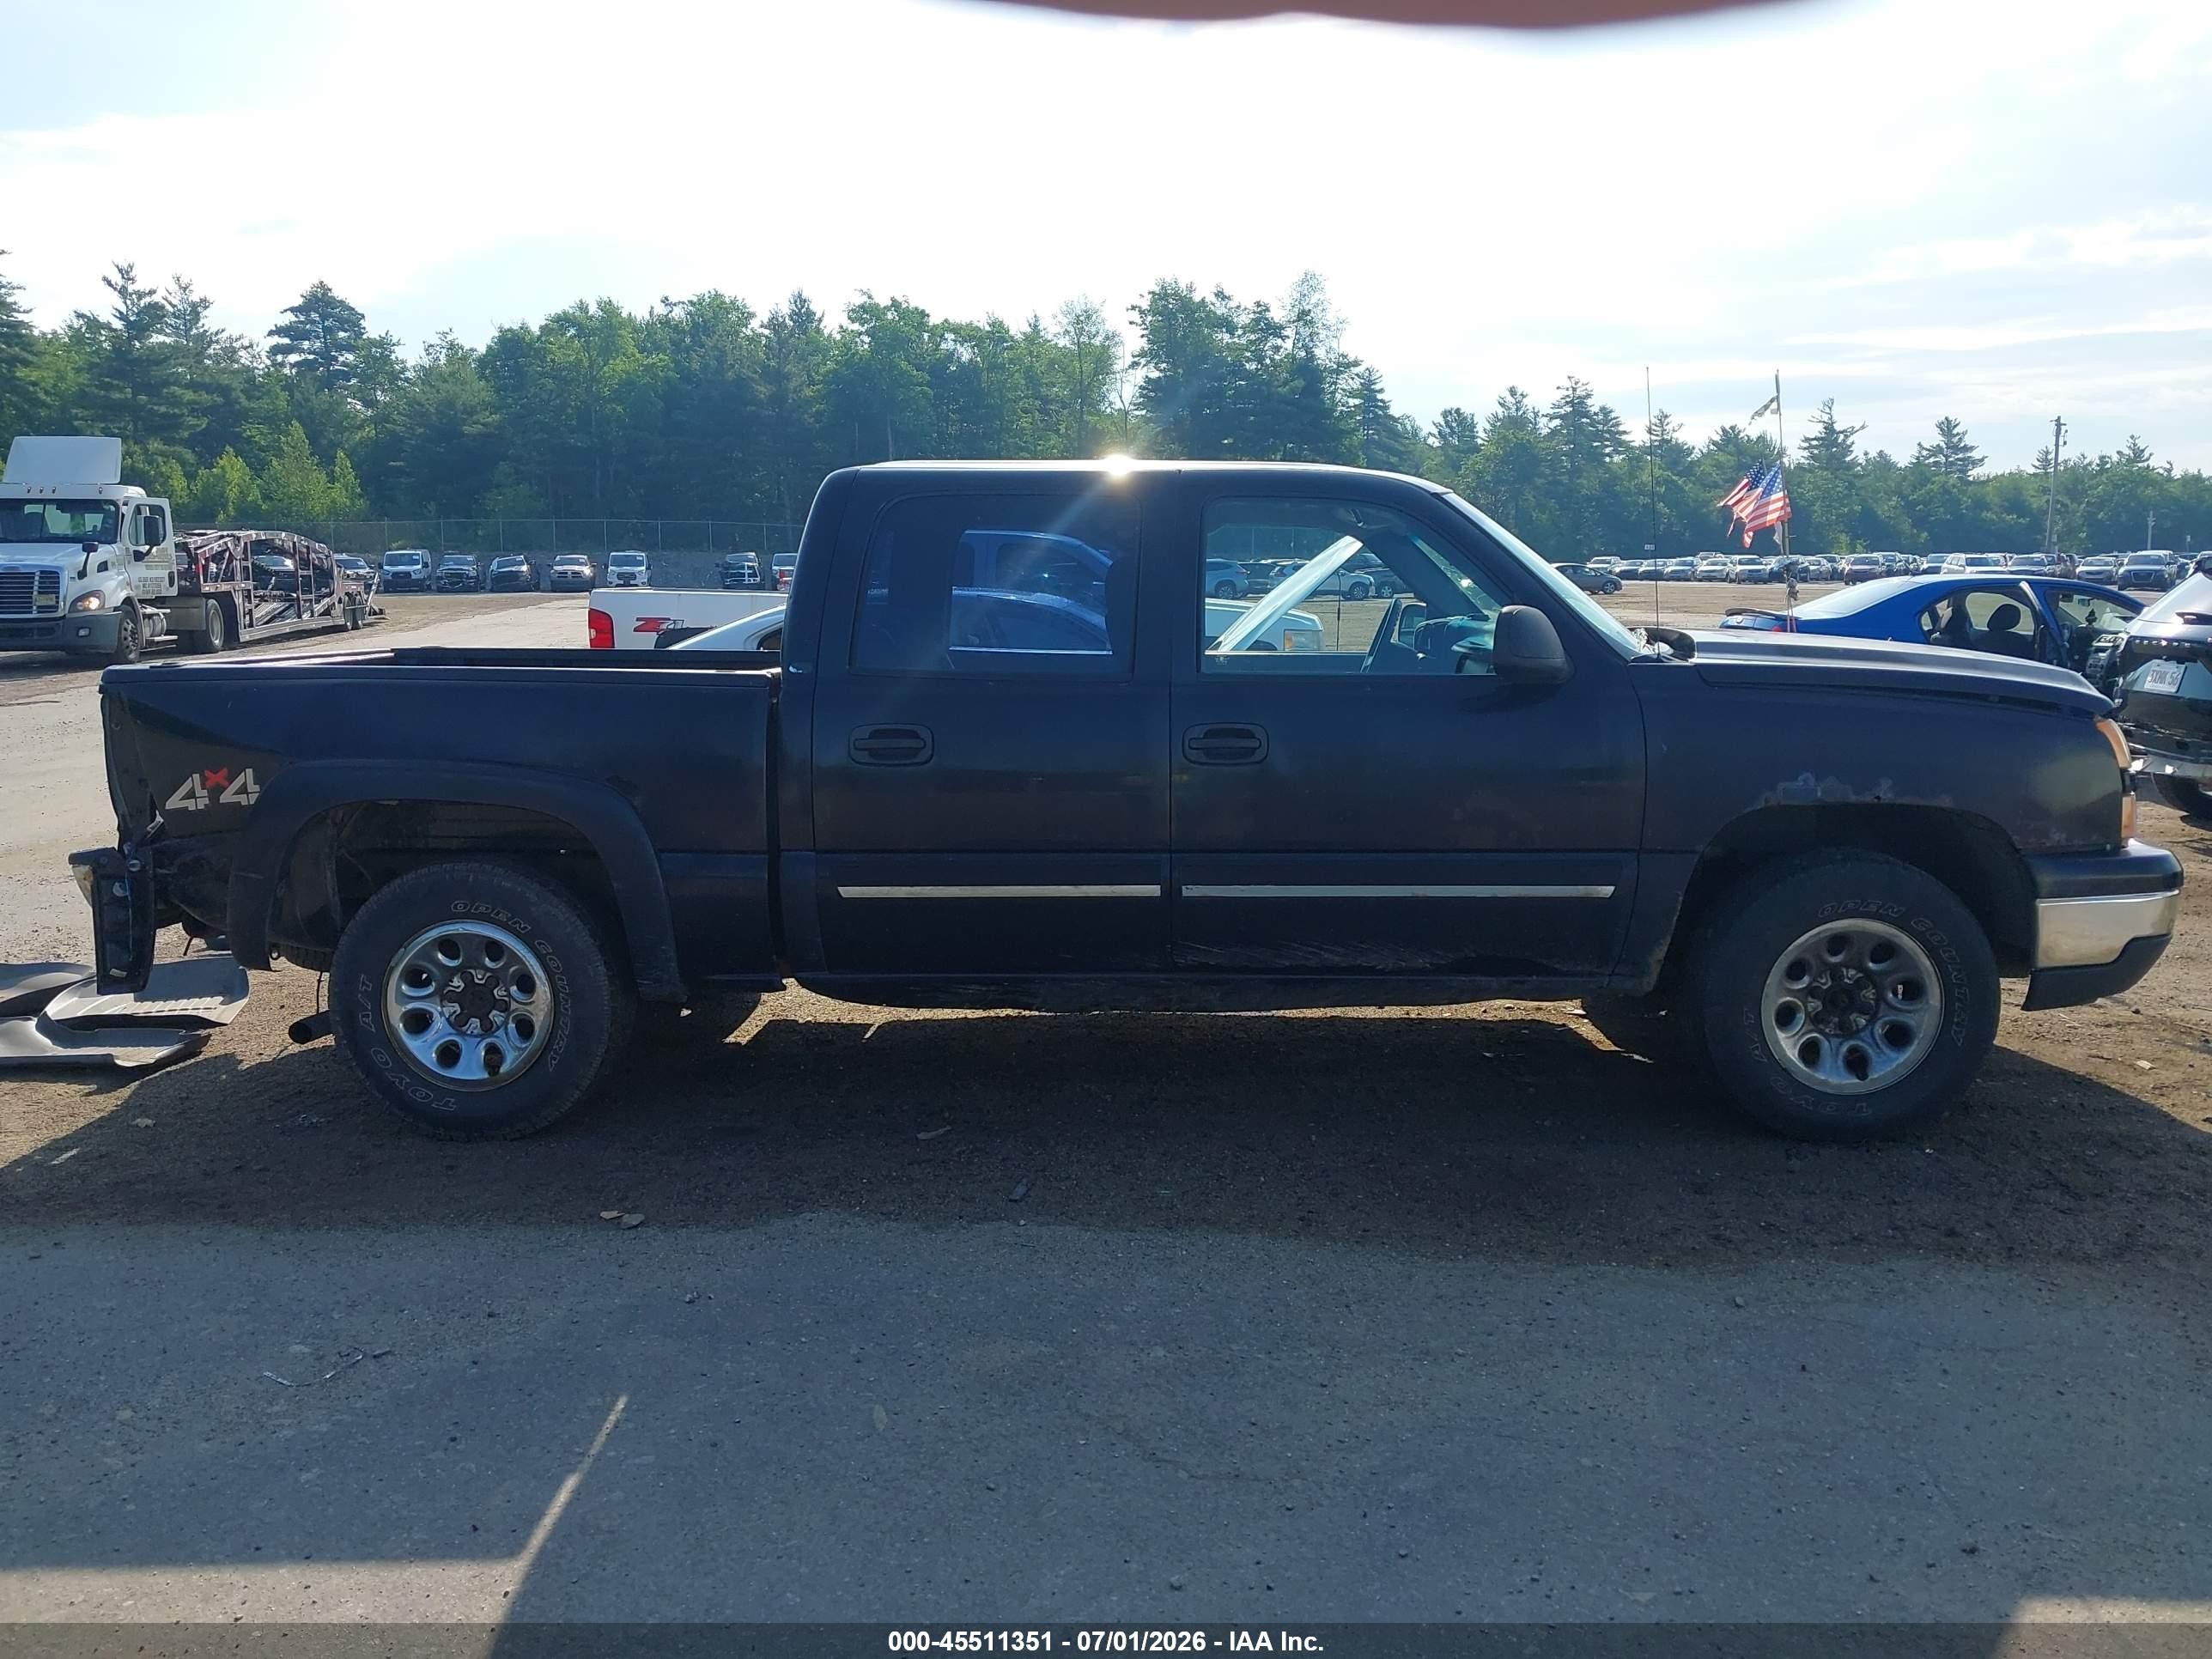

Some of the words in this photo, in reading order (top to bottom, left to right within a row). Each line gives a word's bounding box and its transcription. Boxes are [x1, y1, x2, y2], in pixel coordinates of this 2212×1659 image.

[1818, 899, 1905, 919] OPEN
[358, 975, 376, 1033] A/T
[451, 901, 532, 933] OPEN
[534, 939, 571, 1072] COUNTRY
[371, 1047, 458, 1111] TOYO
